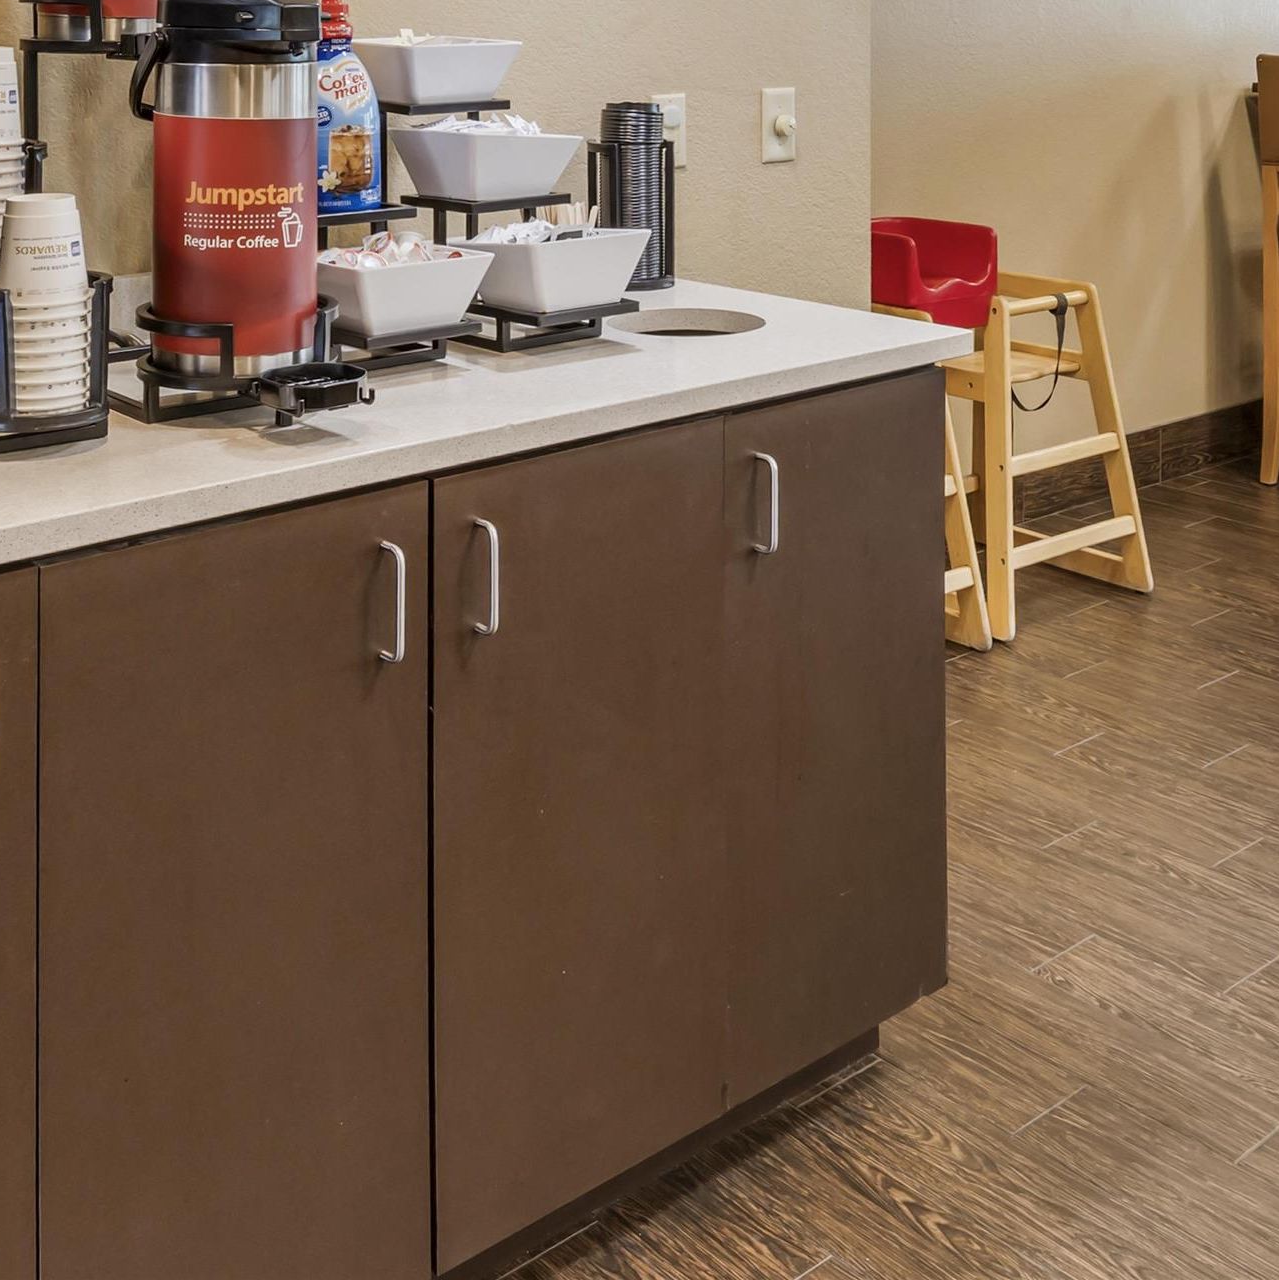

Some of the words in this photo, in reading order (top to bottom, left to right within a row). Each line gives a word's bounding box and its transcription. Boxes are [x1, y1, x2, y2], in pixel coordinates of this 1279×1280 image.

[319, 72, 364, 92] Coffee
[334, 81, 368, 99] mate
[185, 181, 304, 211] Jumpstart
[15, 244, 67, 255] REWARDS
[183, 234, 233, 251] Regular
[236, 235, 279, 249] Coffee
